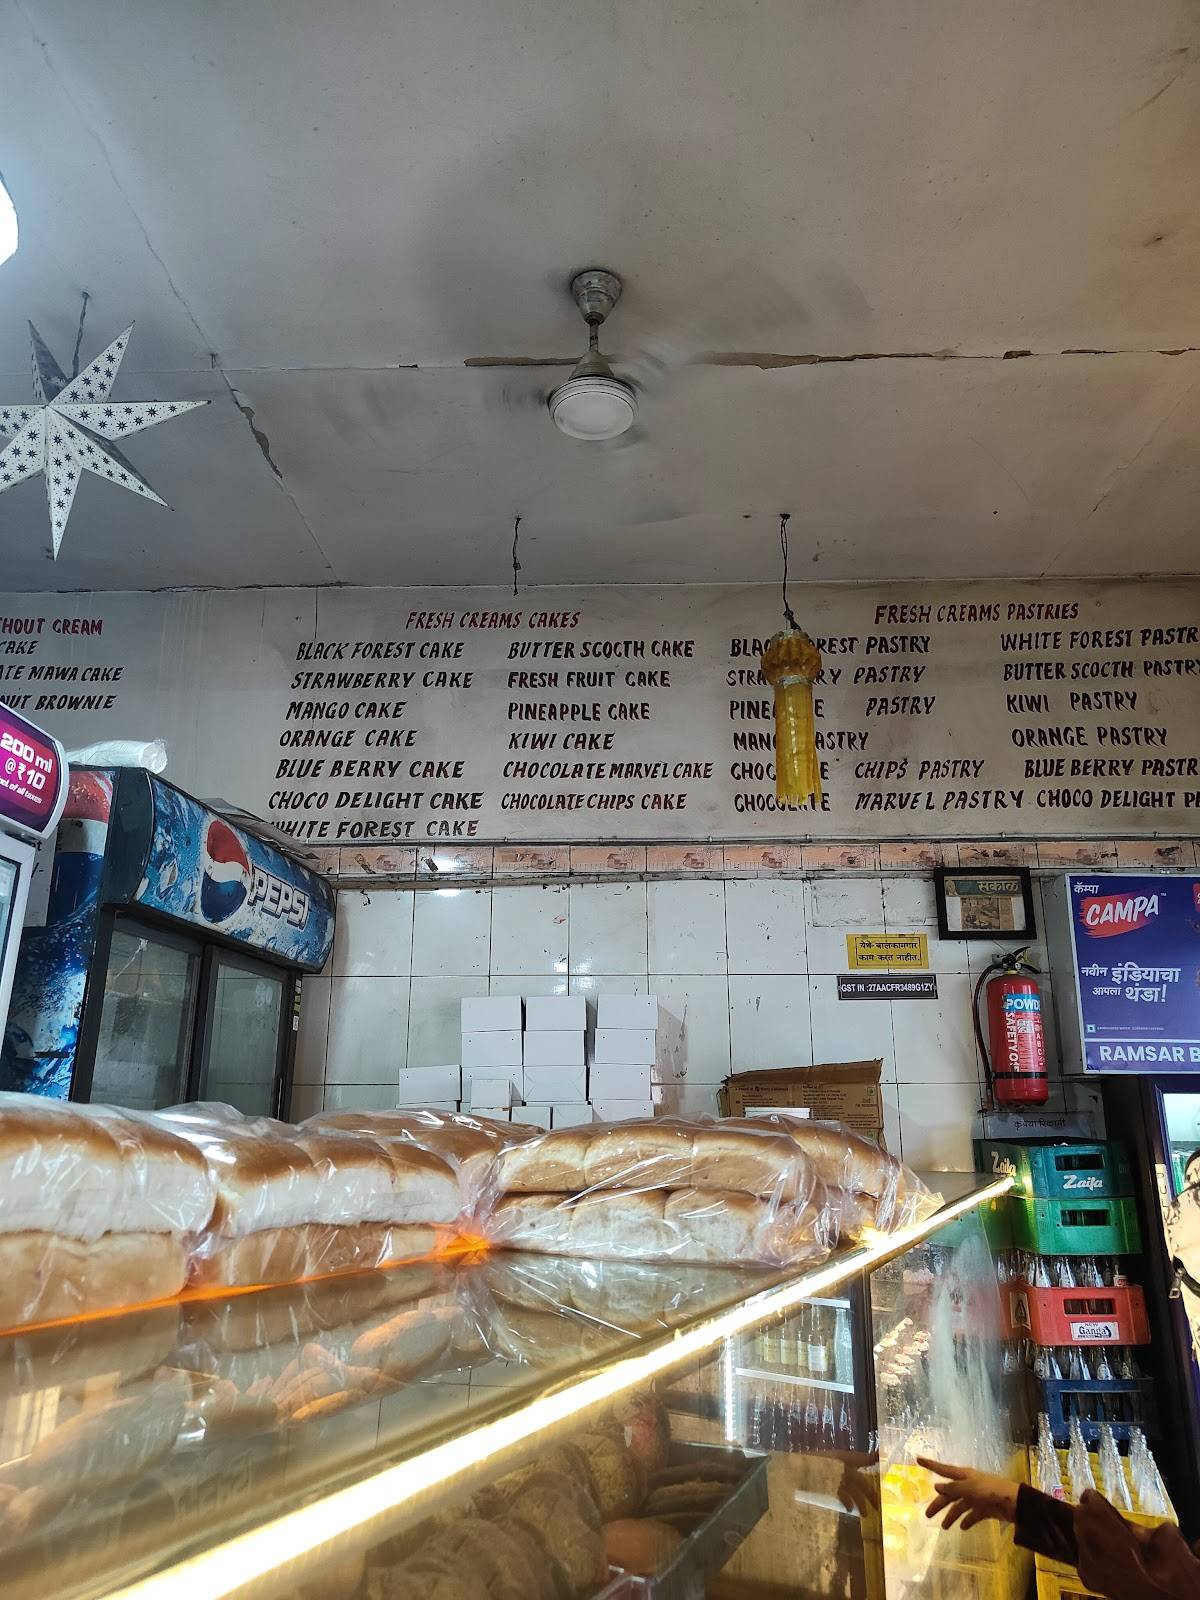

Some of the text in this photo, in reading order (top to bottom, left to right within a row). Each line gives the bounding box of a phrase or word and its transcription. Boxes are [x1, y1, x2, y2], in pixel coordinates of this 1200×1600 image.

[406, 611, 580, 630] FRESH CREAMS CAKES
[874, 603, 1078, 624] FRESH CREAMS PASTRIES
[0, 618, 103, 635] HOUT CREAM
[508, 641, 575, 659] BUTTER
[650, 640, 695, 658] CAKE
[866, 636, 930, 655] PASTRY
[1000, 631, 1062, 651] WHITE
[1069, 630, 1132, 649] FOREST
[296, 641, 464, 661] BLACK FOREST CAKE
[28, 666, 79, 681] MAWA
[81, 667, 125, 681] CAKE
[291, 671, 474, 690] STRAWBERRY CAKE
[508, 670, 671, 688] FRESH FRUIT CAKE
[854, 665, 926, 684] PASTRY
[1003, 662, 1066, 681] BUTTER
[35, 695, 116, 710] BROWNIE
[285, 701, 407, 720] MANGO CAKE
[508, 703, 650, 721] PINEAPPLE CAKE
[866, 696, 935, 716] PASTRY
[1006, 692, 1137, 713] KIWI PASTRY
[279, 729, 418, 748] ORANGE CAKE
[508, 732, 615, 750] KIWI CAKE
[815, 731, 868, 751] ASTRY
[1012, 727, 1167, 747] ORANGE PASTRY
[1, 732, 53, 774] 200 ml
[275, 759, 465, 779] BLUE BERRY CAKE
[503, 761, 714, 779] CHOCOLATE MARVEL CAKE
[855, 760, 908, 780] CHIPS
[919, 759, 985, 779] PASTRY
[1025, 759, 1064, 778] BLUE
[1070, 758, 1132, 777] BERRY
[268, 791, 485, 810] CHOCO DELIGHT CAKE
[501, 793, 687, 811] CHOCOLATE CHIPS CAKE
[855, 791, 935, 811] MARVEL
[943, 791, 1024, 811] PASTRY
[1036, 790, 1092, 808] CHOCO
[1101, 791, 1175, 808] DELIGHT
[336, 820, 415, 838] FOREST
[425, 819, 479, 837] CAKE
[248, 864, 309, 930] PEPSI
[1086, 894, 1159, 926] CAMPA
[1081, 962, 1181, 984] नवीन इंडियाचा
[841, 984, 855, 992] GST
[1092, 983, 1167, 1002] आपला थंडा!
[1100, 1046, 1185, 1062] RAMSAR
[1079, 1325, 1107, 1337] Ganga
